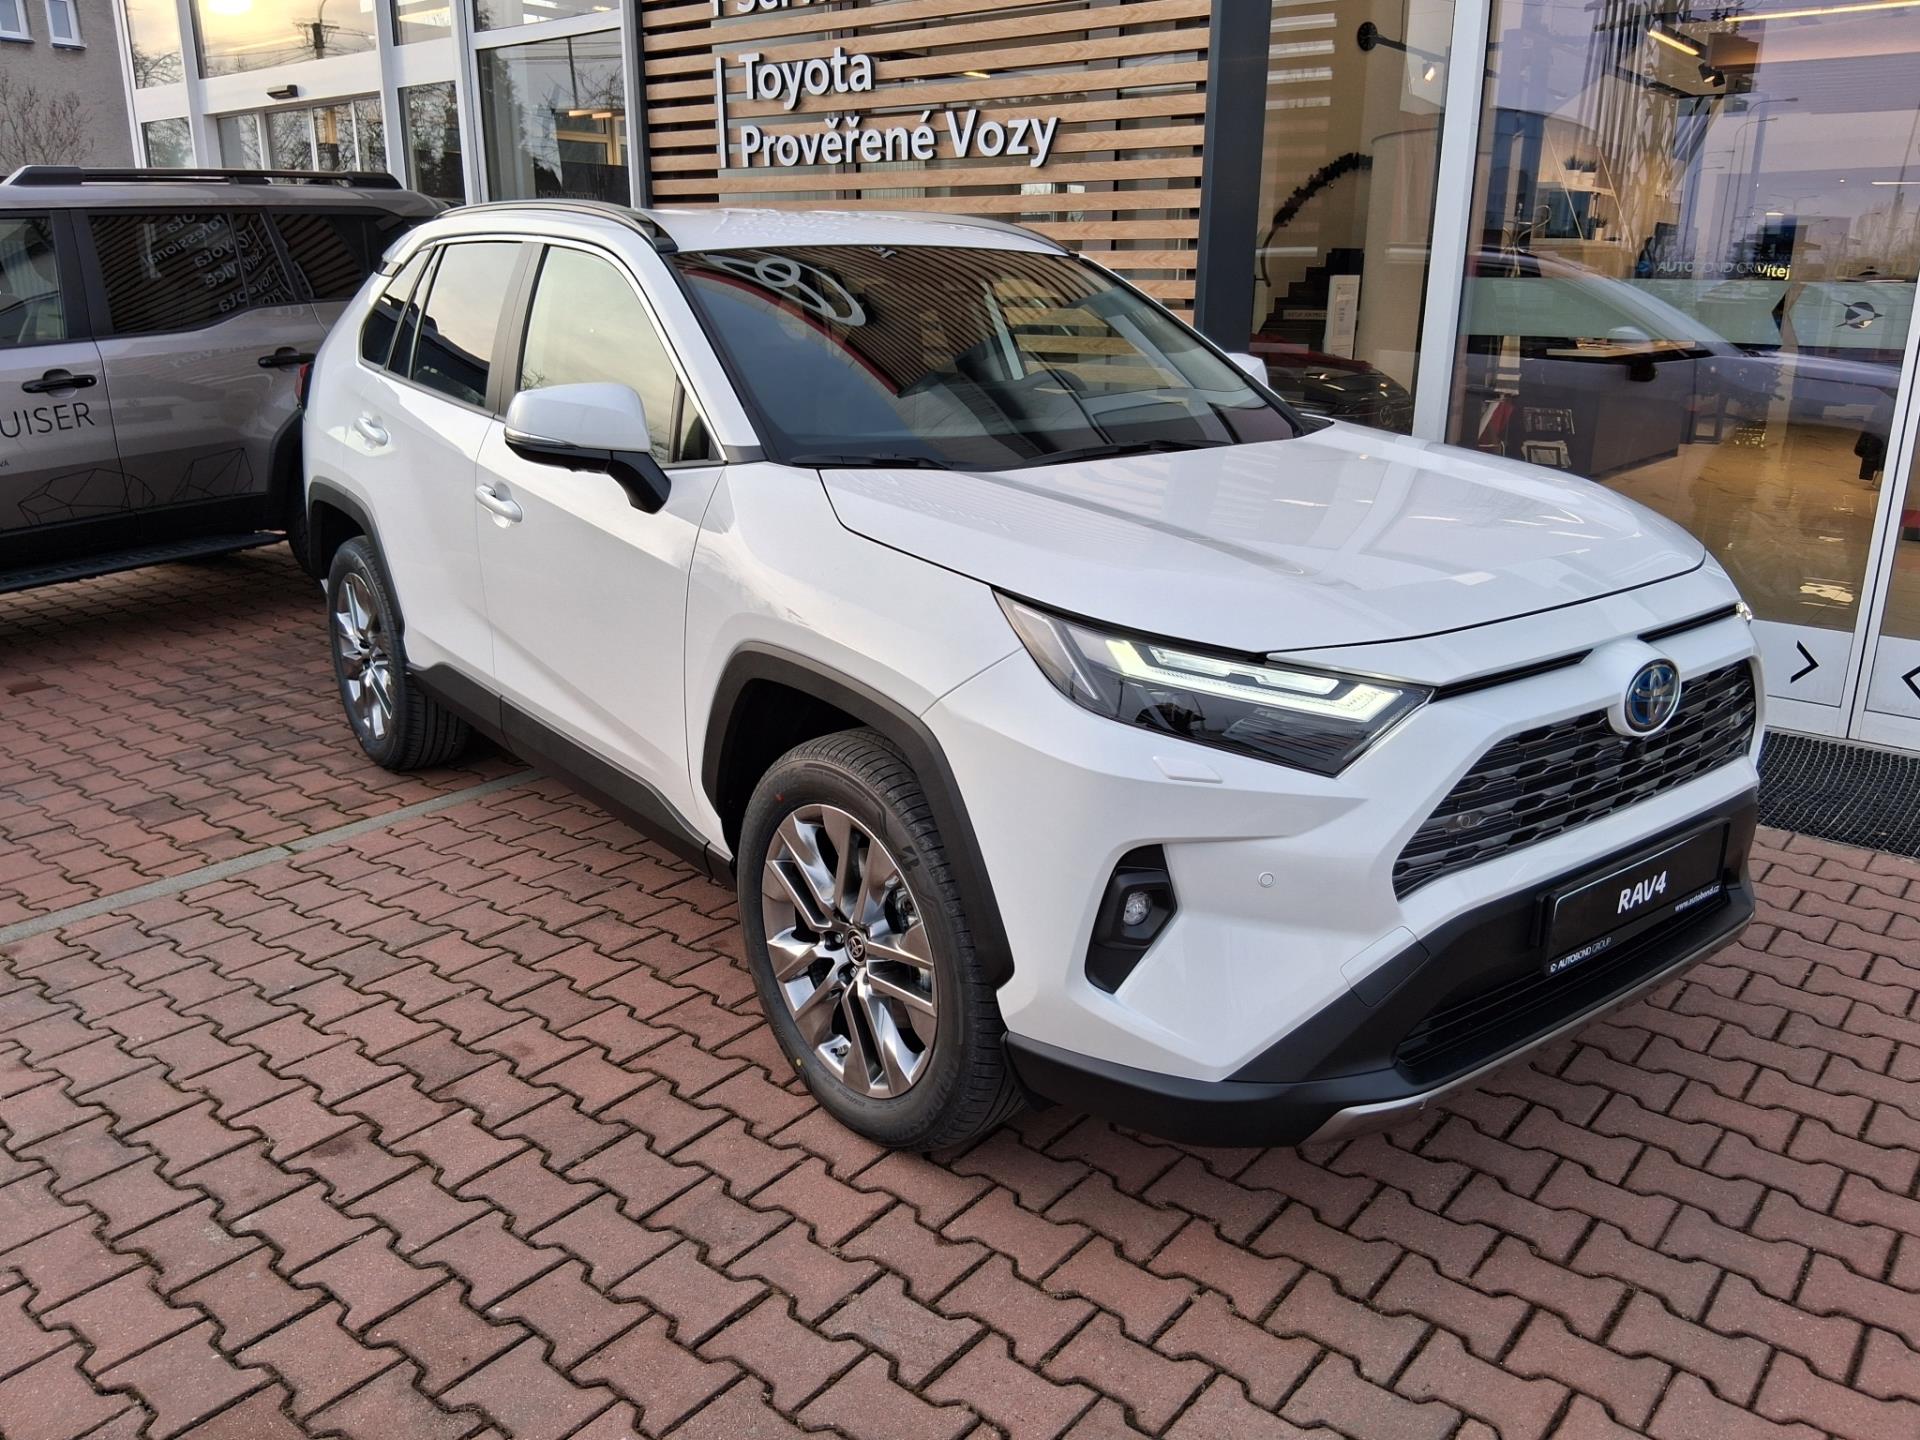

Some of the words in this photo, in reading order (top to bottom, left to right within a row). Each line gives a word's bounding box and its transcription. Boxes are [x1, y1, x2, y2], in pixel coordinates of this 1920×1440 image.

[738, 46, 874, 111] Toyota
[741, 110, 936, 168] Prověřené
[945, 109, 1059, 168] Vozy
[0, 402, 95, 438] UISER
[1617, 870, 1668, 914] RAV4
[1557, 946, 1592, 970] AUTOBOND
